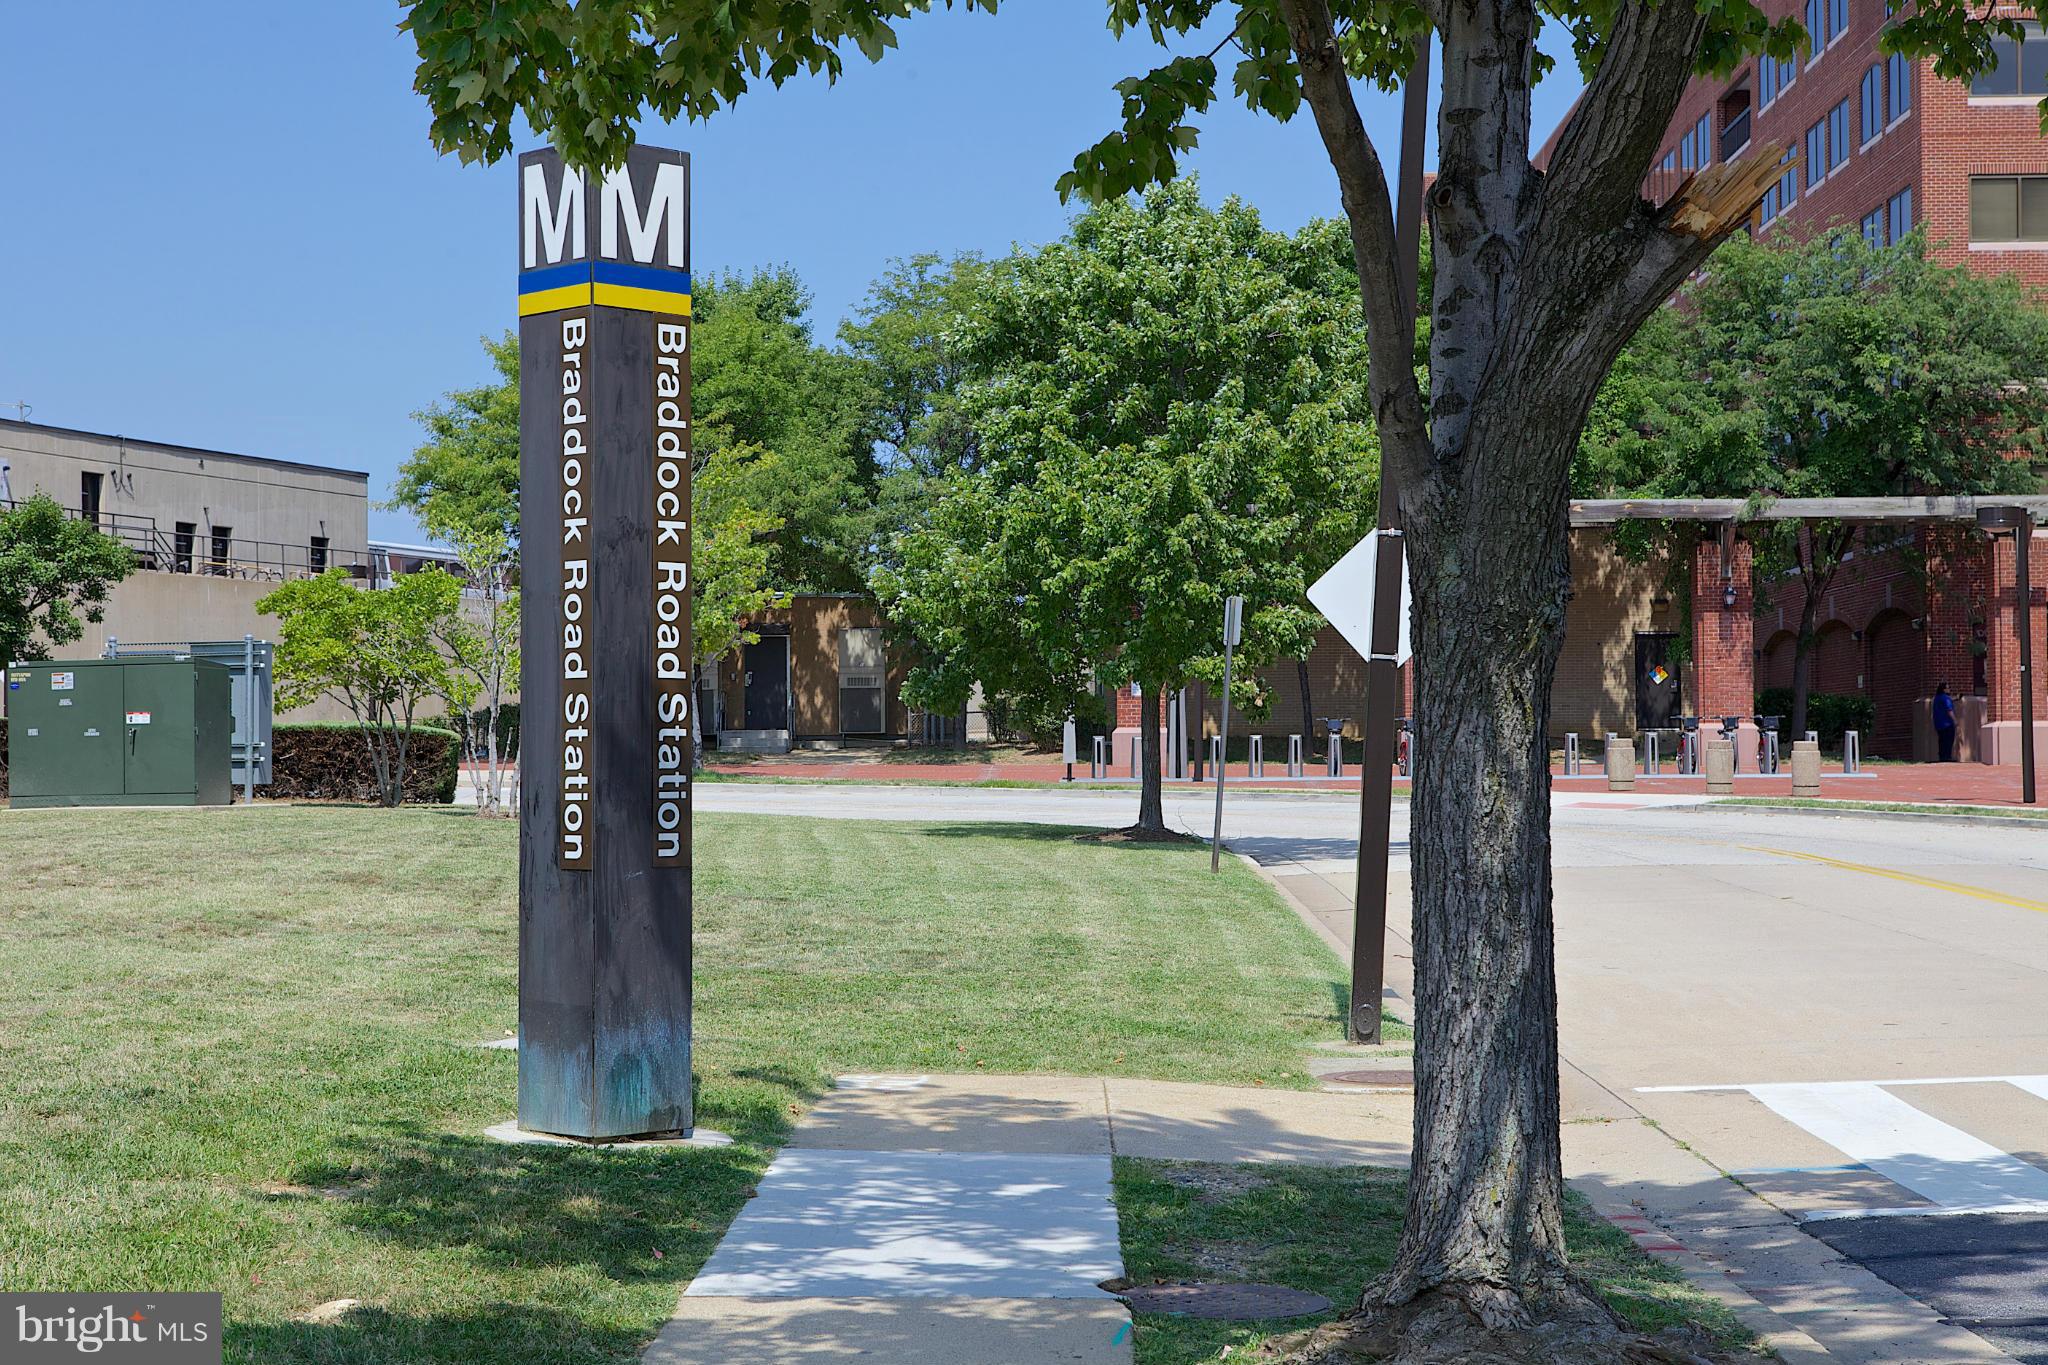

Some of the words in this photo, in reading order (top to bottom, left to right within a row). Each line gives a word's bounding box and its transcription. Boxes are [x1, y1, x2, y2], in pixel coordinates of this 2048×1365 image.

[524, 163, 586, 269] M
[601, 160, 684, 268] M
[562, 317, 588, 544] Braddock
[657, 323, 687, 546] Braddock
[563, 559, 588, 680] Road
[656, 561, 687, 680] Road
[563, 693, 590, 860] Station
[656, 693, 688, 858] Station
